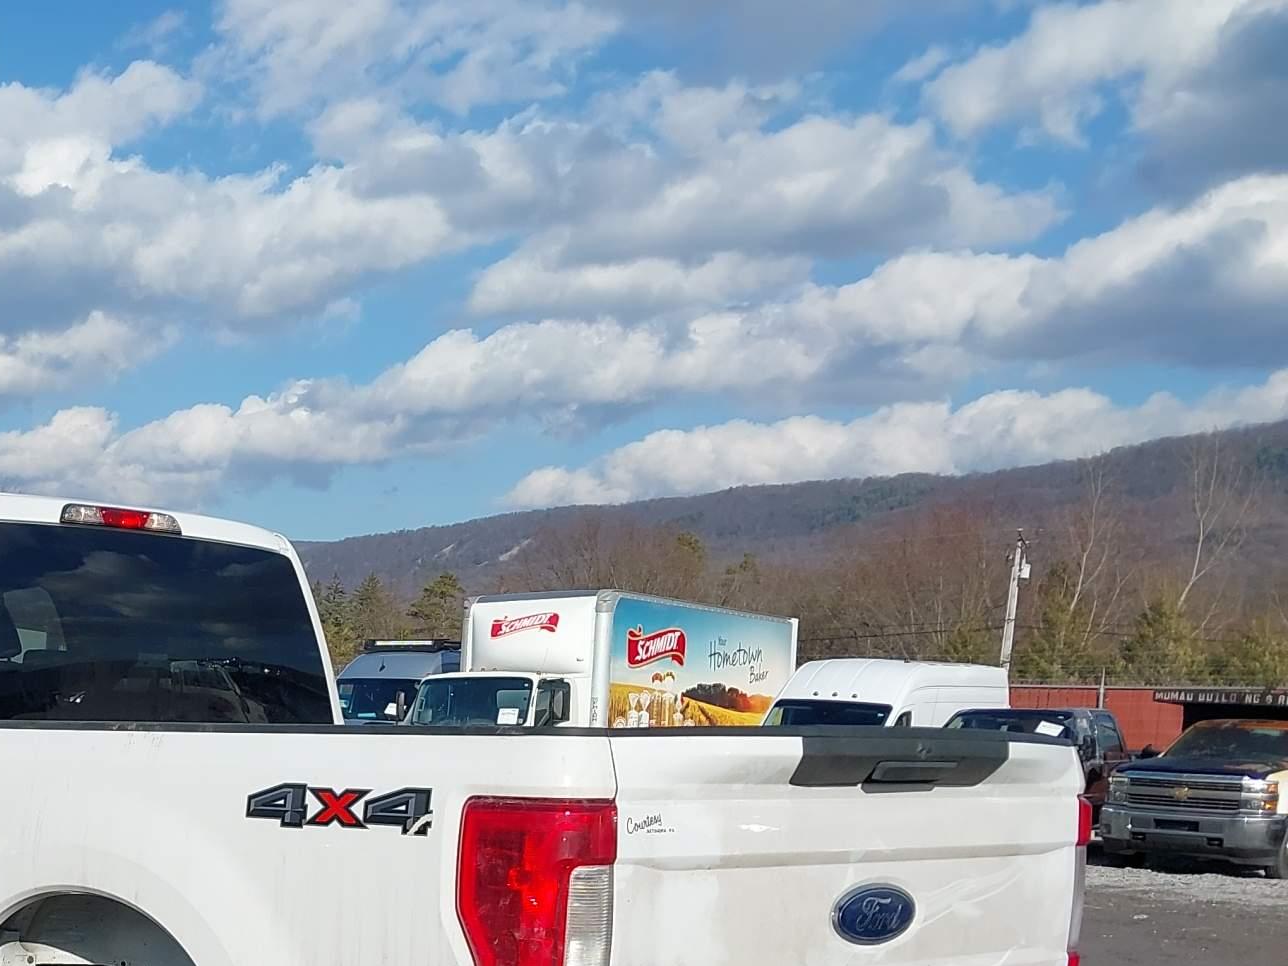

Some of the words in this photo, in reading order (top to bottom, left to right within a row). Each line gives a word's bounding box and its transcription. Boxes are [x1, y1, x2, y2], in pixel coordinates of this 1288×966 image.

[499, 613, 552, 635] SCHMIDT
[635, 631, 679, 661] SCHMIDT
[708, 641, 763, 672] Hometown
[749, 665, 769, 684] Baker
[627, 813, 662, 834] Courtesy
[855, 895, 905, 933] Ford
